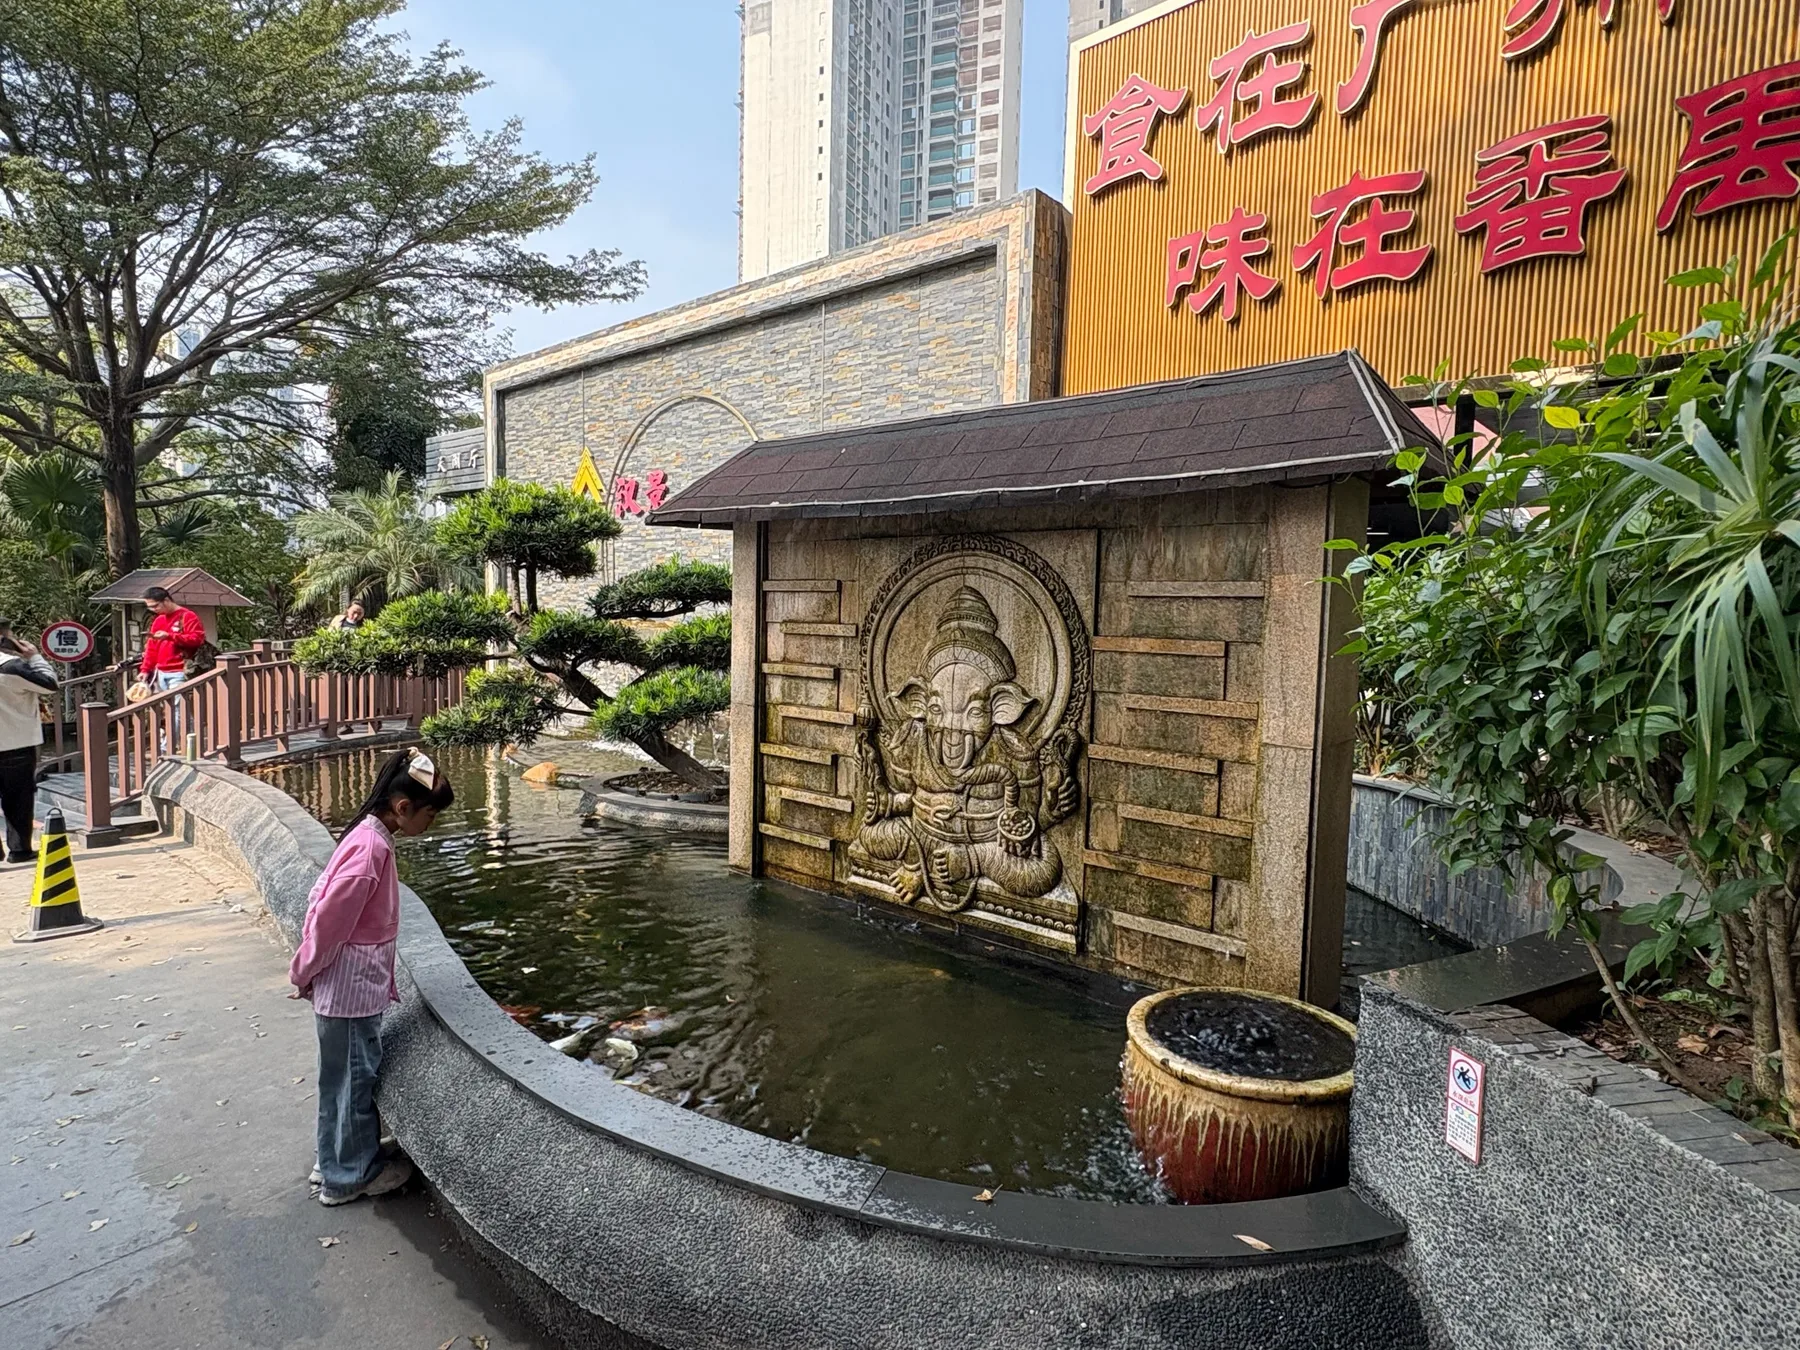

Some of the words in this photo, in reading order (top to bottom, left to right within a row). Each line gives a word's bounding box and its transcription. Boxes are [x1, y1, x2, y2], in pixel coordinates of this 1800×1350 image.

[1166, 60, 1800, 323] 味在番禺
[55, 629, 79, 646] 慢
